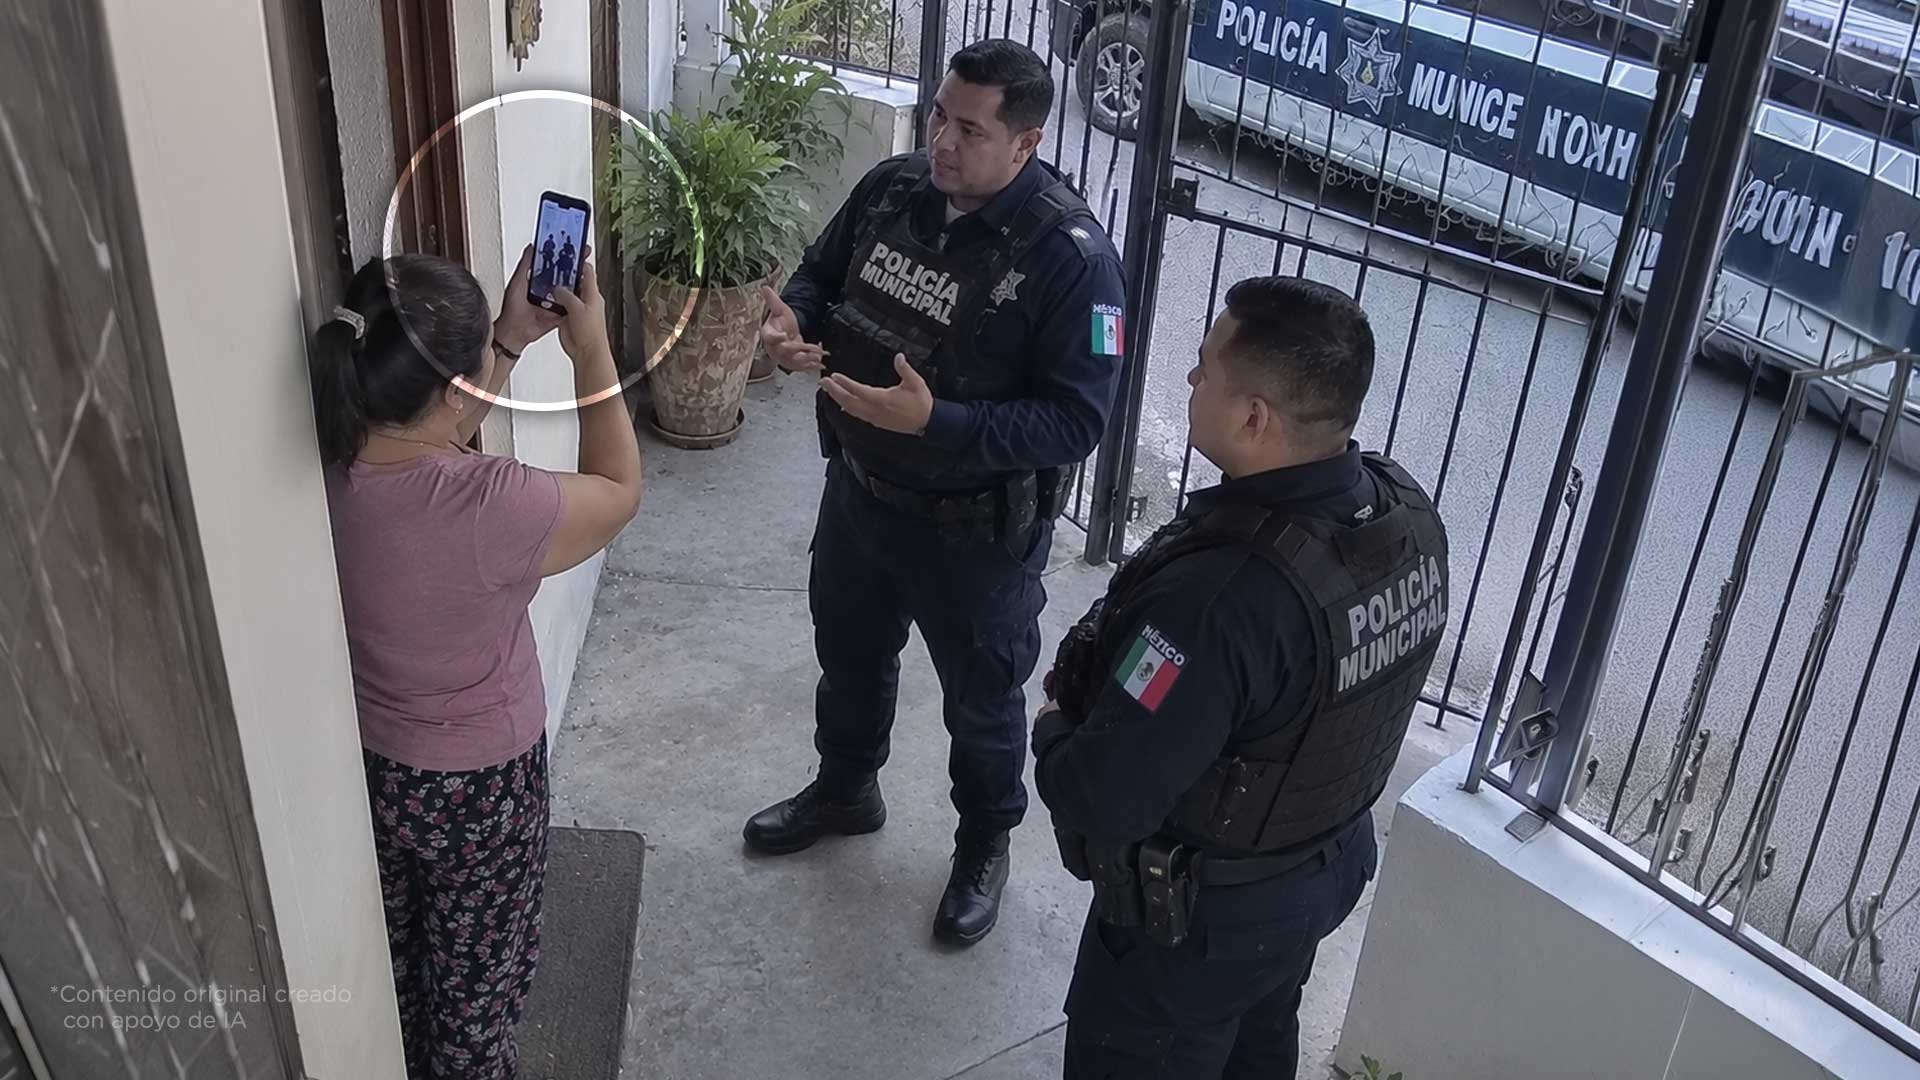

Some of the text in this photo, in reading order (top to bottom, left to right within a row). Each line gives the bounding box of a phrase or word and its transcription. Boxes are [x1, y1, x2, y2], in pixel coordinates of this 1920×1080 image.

[1215, 0, 1329, 74] POLICÍA
[859, 261, 952, 327] MUNICIPAL
[868, 241, 960, 306] POLICÍA
[1348, 554, 1442, 647] POLICÍA
[1338, 592, 1446, 692] MUNICIPAL
